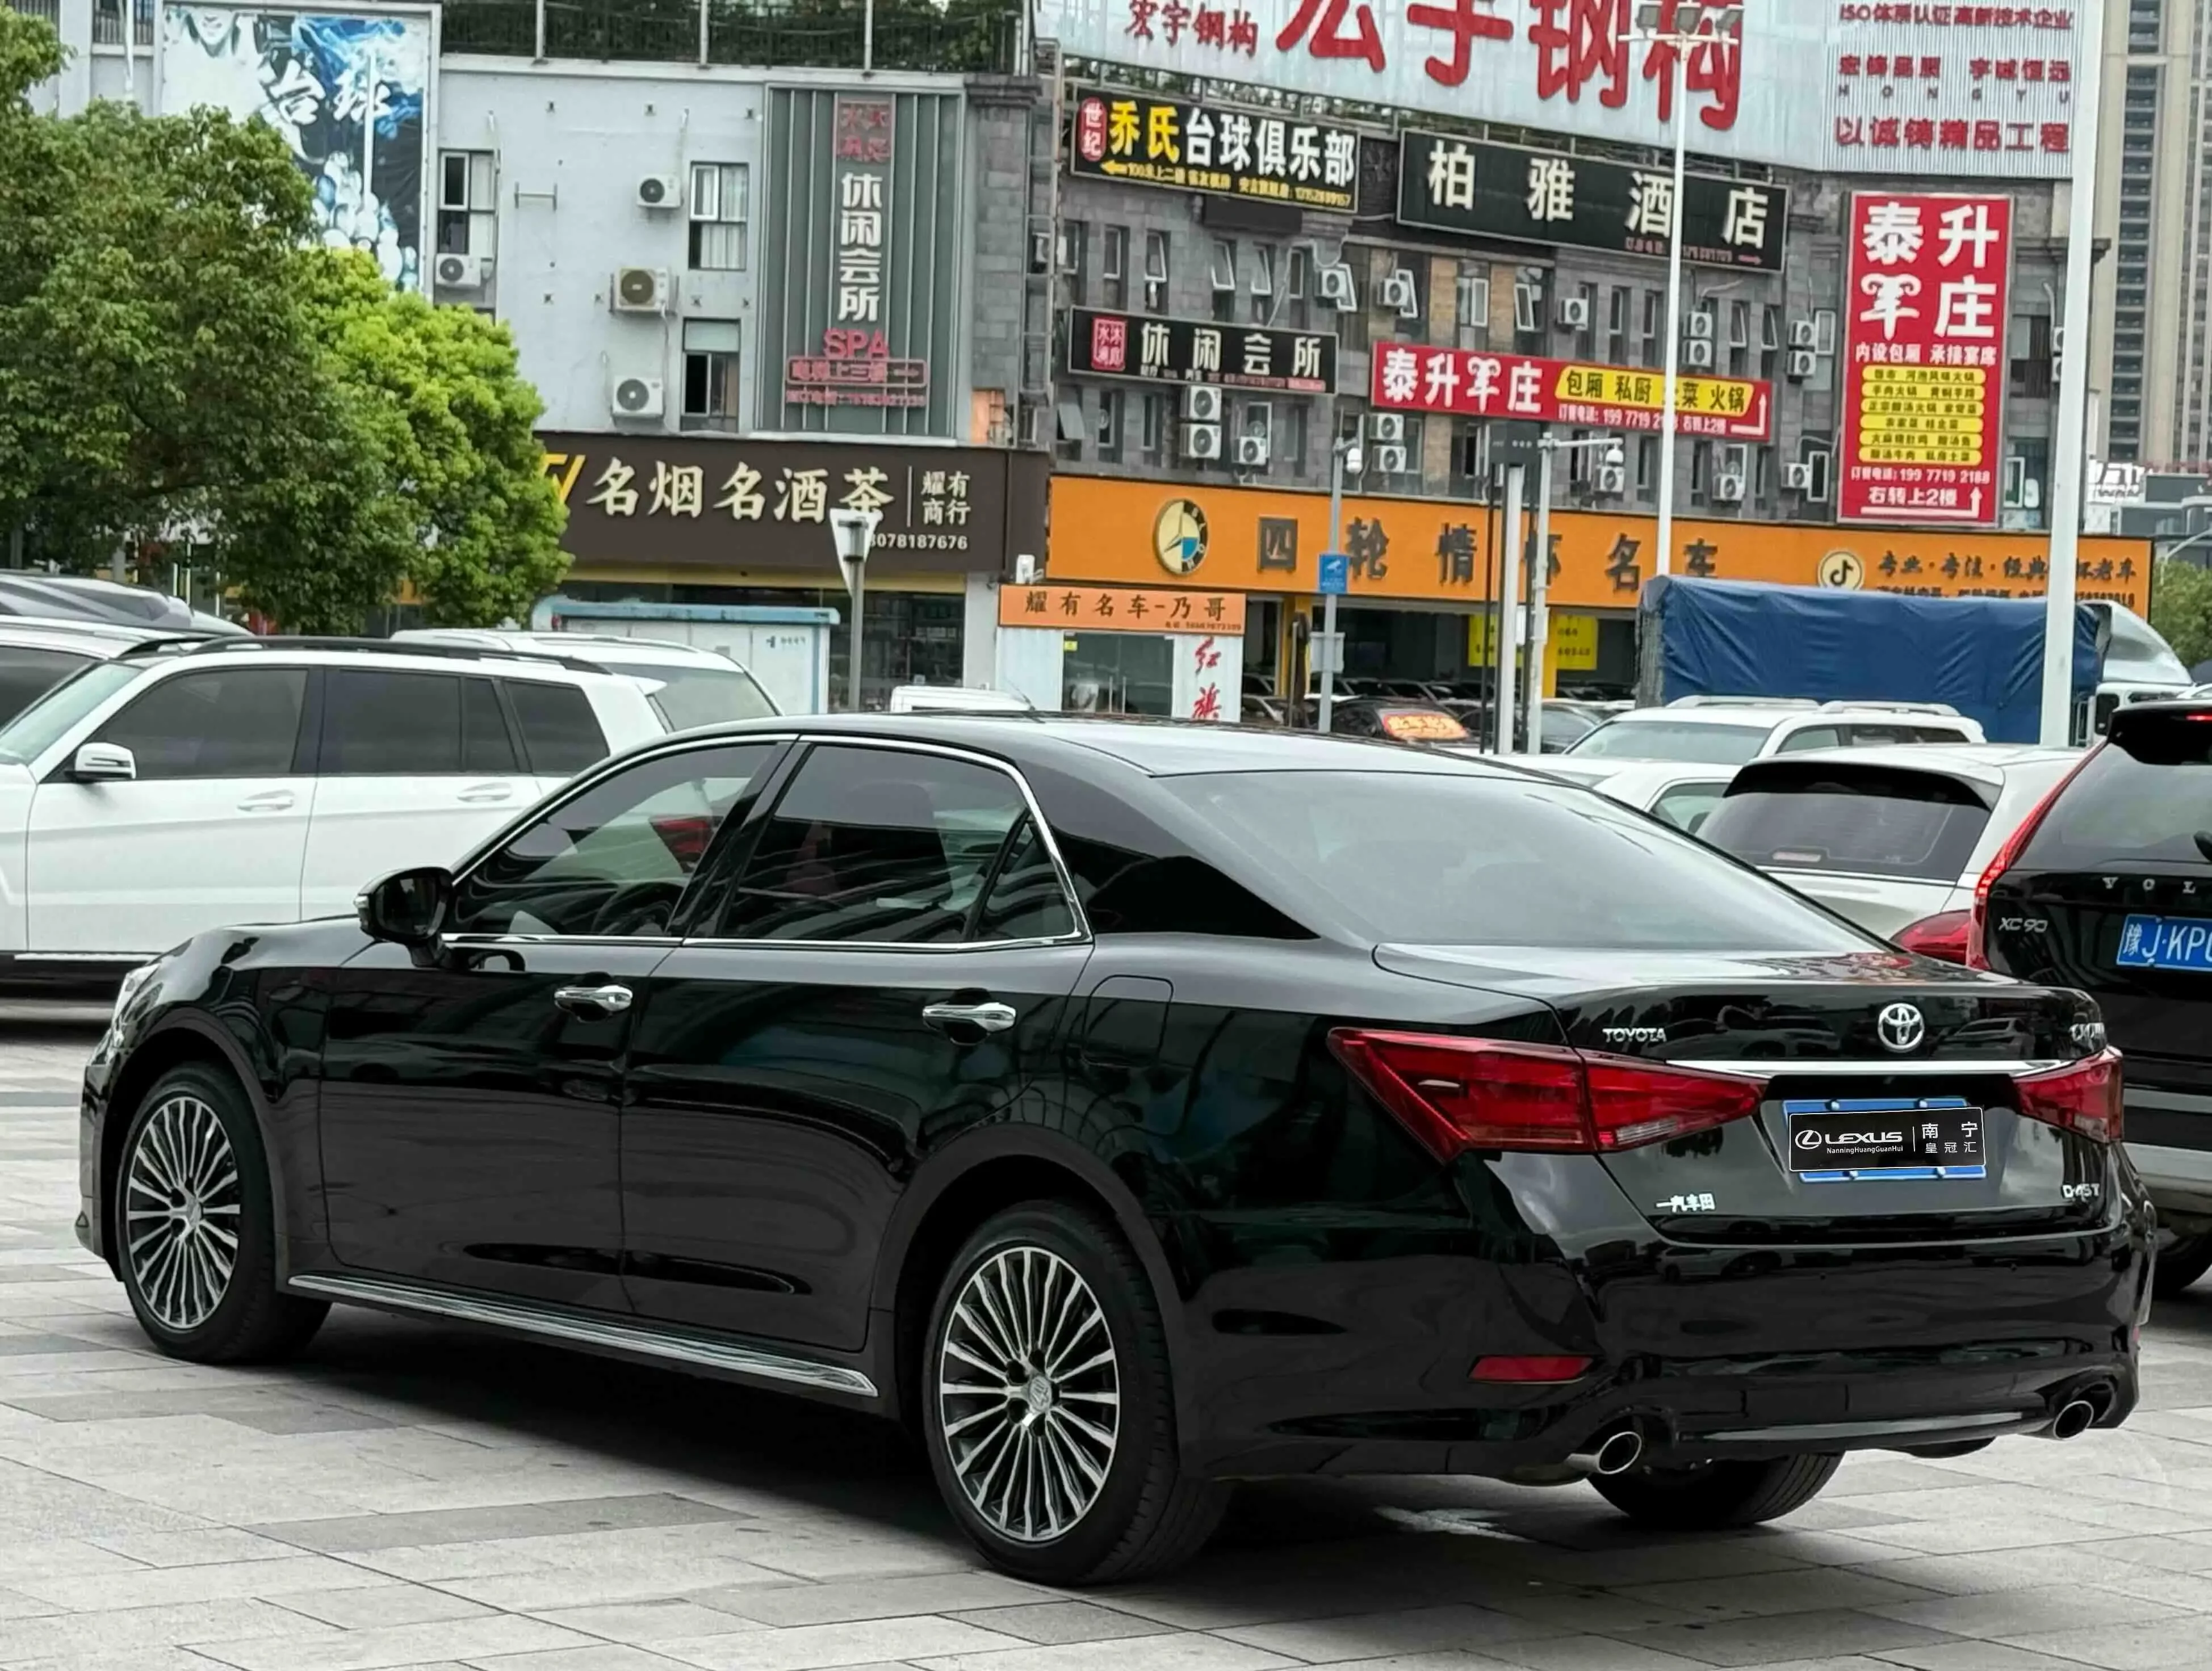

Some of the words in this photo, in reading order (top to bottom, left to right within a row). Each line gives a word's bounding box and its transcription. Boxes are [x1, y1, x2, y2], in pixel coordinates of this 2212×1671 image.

[1109, 100, 1356, 186] 乔氏台球俱乐部
[1427, 139, 1768, 250] 柏雅酒店
[838, 172, 883, 321] 休闲会所
[1863, 201, 2000, 268] 泰升
[823, 328, 889, 359] SPA
[1141, 321, 1322, 378] 休闲会所
[1567, 370, 1603, 398] 包厢
[1710, 384, 1745, 413] 火锅
[585, 457, 893, 522] 名烟名酒茶
[923, 498, 971, 525] 商行
[1999, 917, 2048, 933] XC90
[1602, 1027, 1666, 1043] TOYOTA
